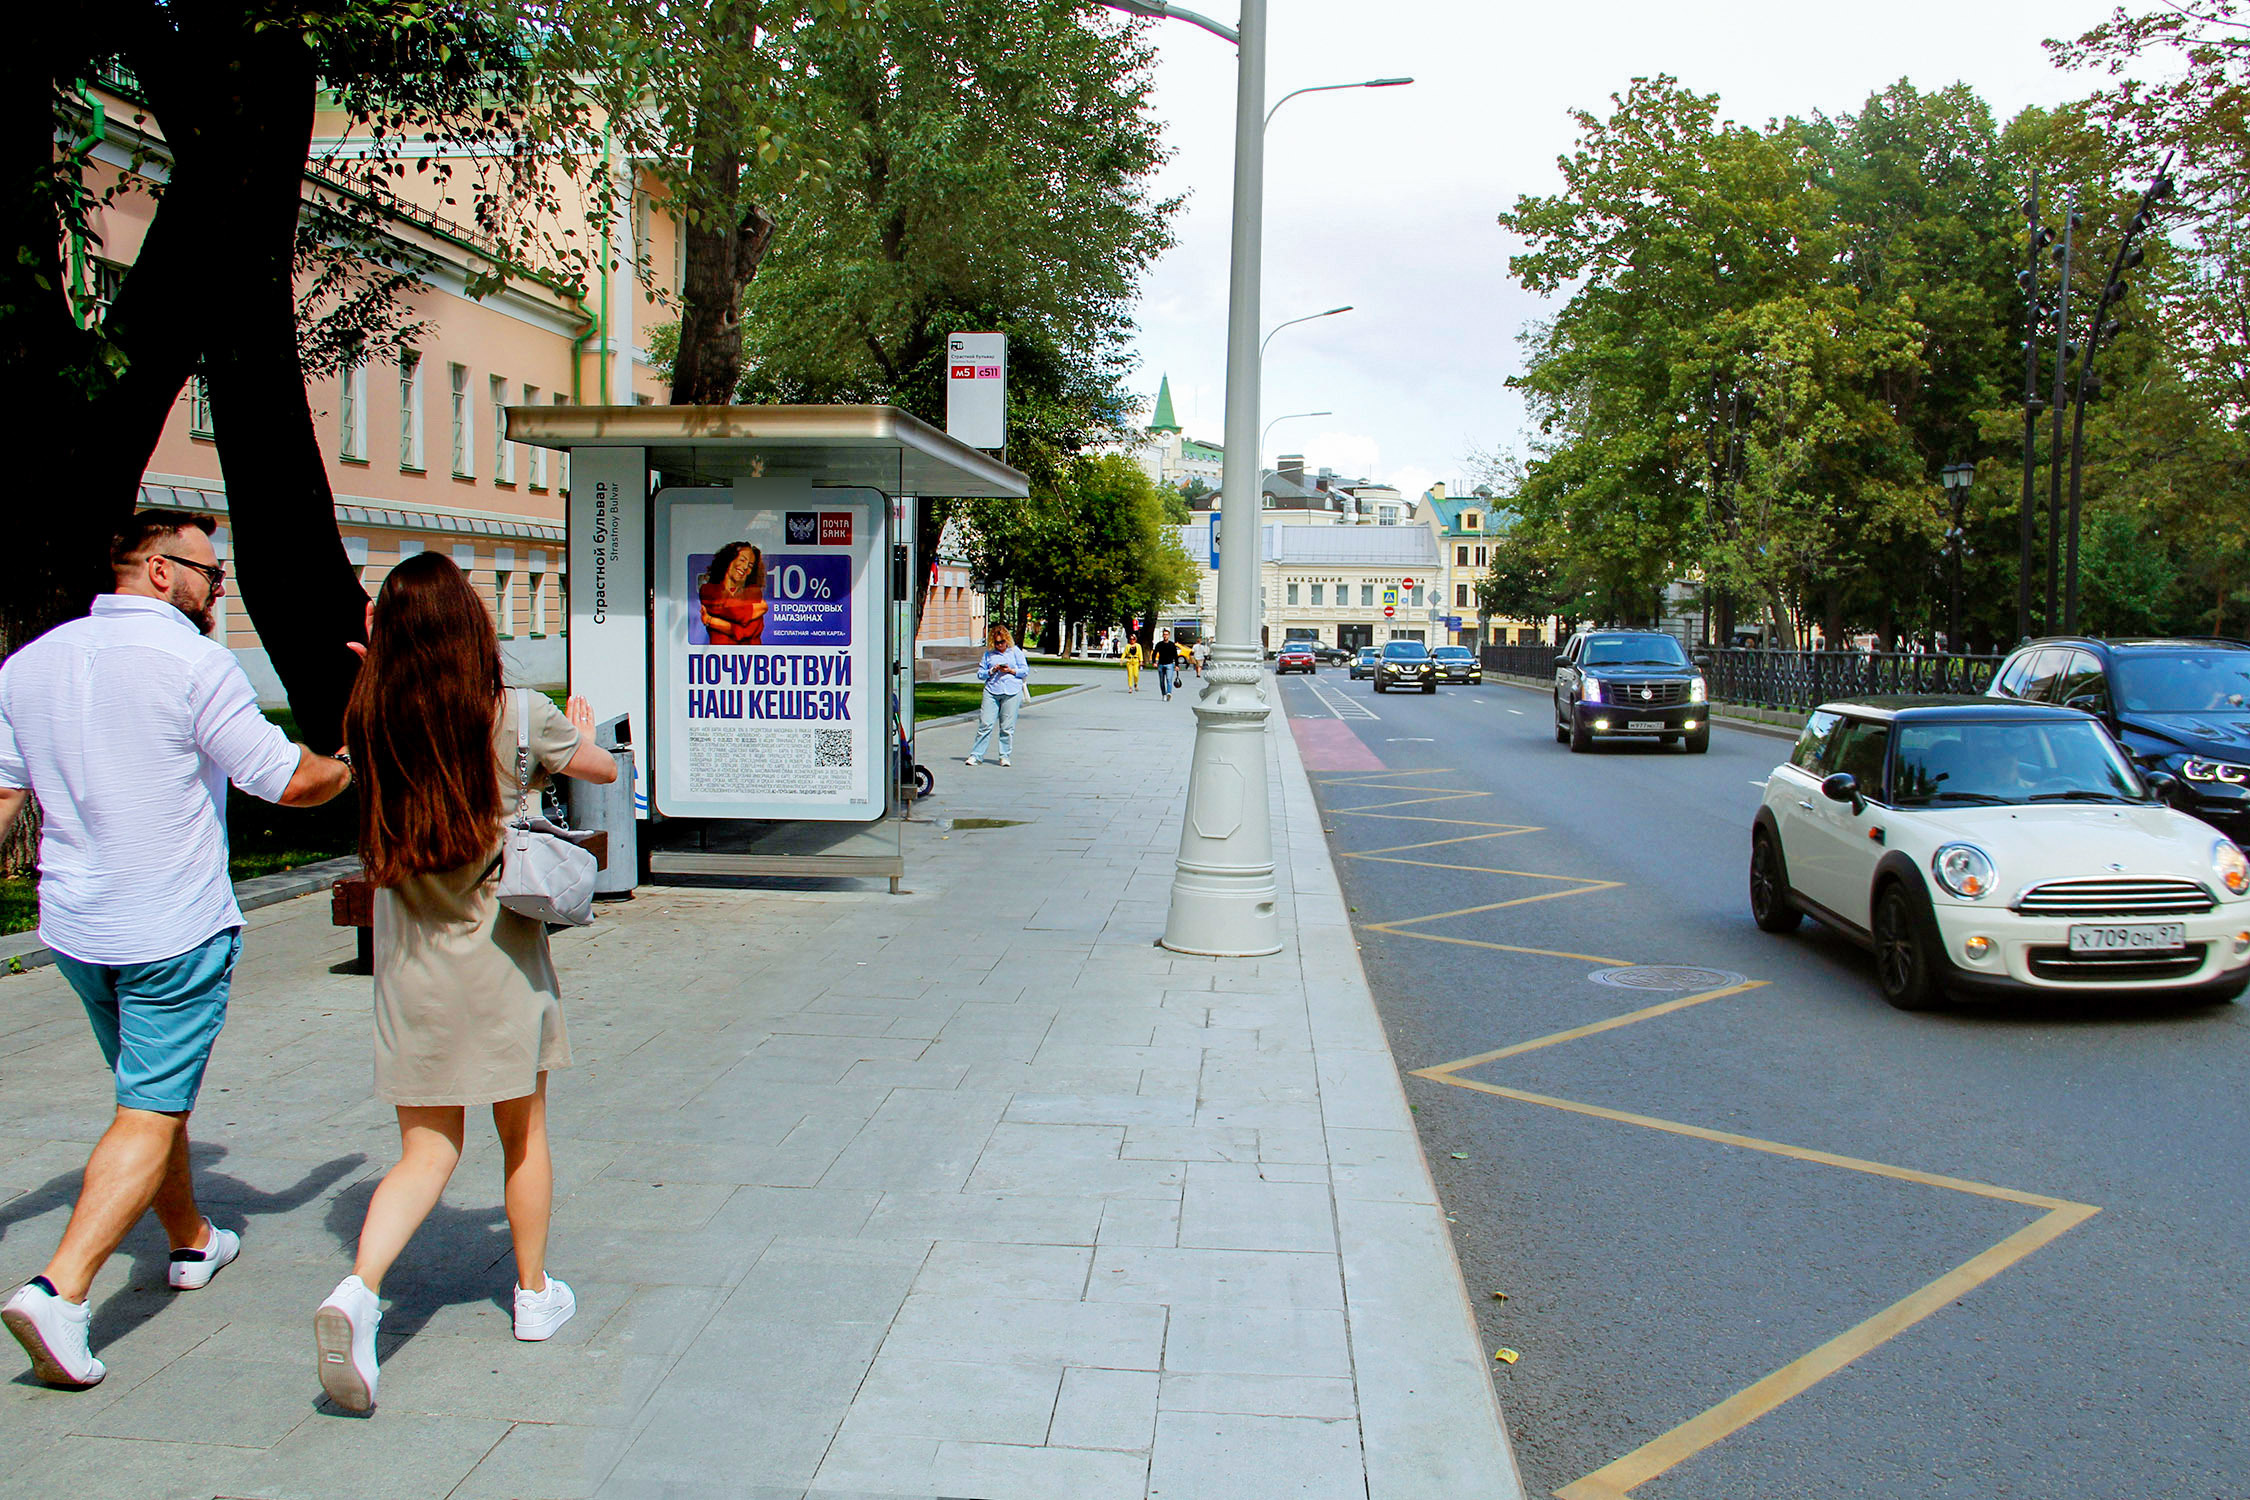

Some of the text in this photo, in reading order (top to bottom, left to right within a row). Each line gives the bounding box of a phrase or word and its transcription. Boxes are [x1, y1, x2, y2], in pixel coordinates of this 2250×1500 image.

[610, 482, 620, 562] Strastnoy Bulvar
[822, 519, 850, 528] ПОЧТА
[822, 529, 846, 538] БАНК
[593, 481, 608, 625] Страстной бульвар
[773, 604, 843, 614] В ПРОДУКТОВЫХ
[773, 613, 823, 622] МАГАЗИНАХ
[688, 650, 852, 686] ПОЧУВСТВУЙ
[688, 689, 851, 720] НАШ КЕШБЭК
